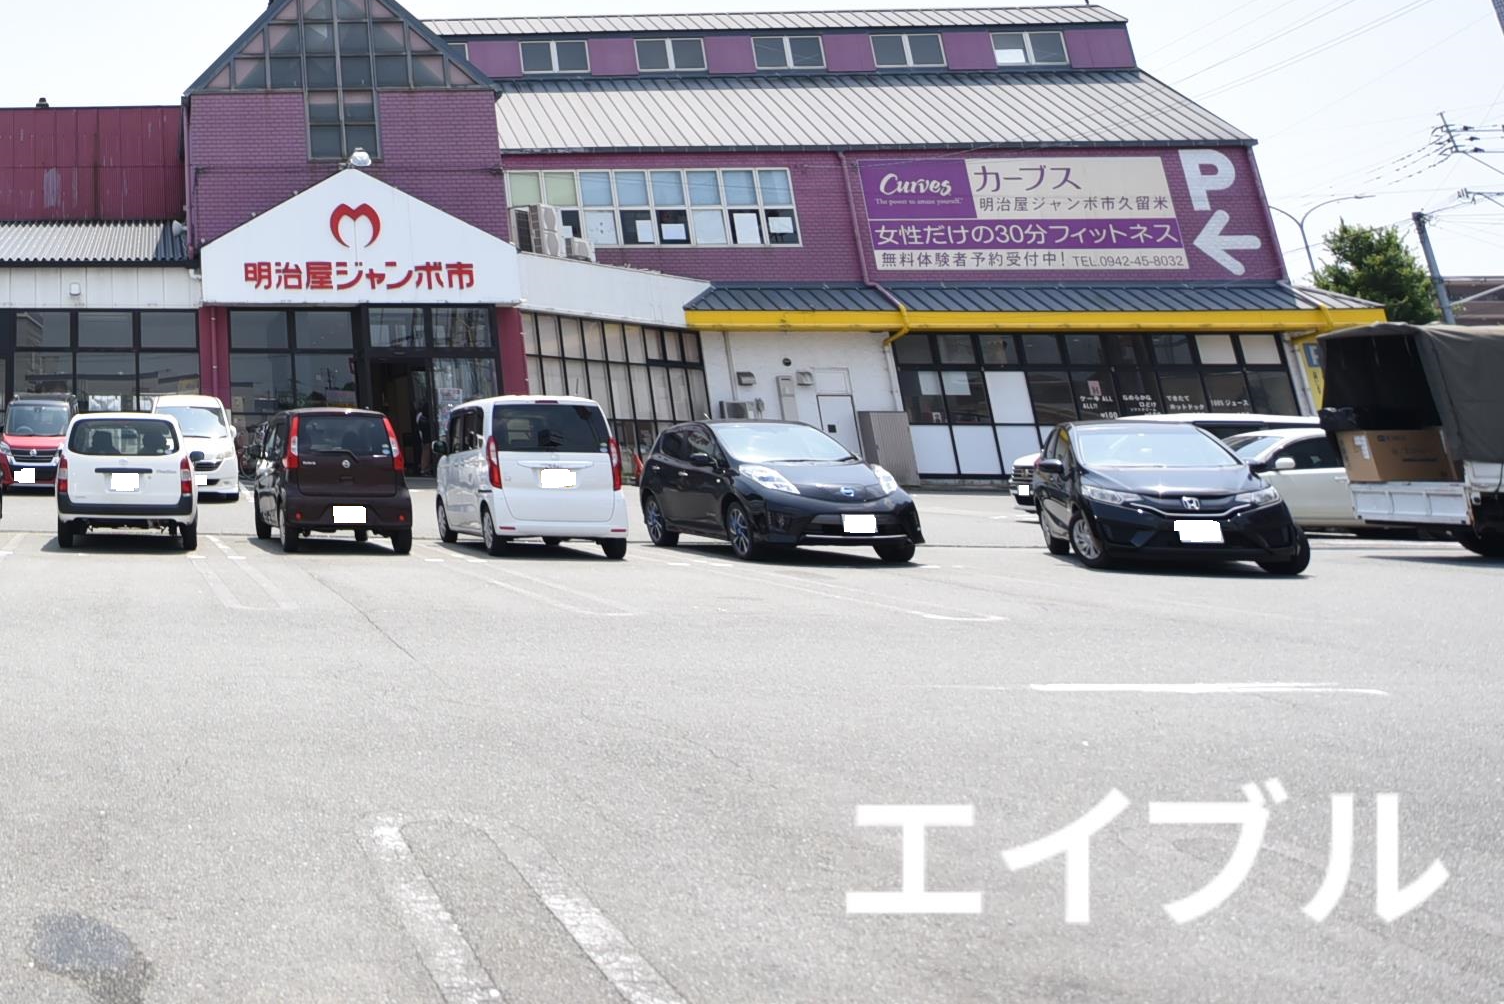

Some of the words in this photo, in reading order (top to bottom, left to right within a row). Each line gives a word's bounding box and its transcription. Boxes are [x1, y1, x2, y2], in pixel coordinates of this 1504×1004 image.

[879, 173, 952, 196] Curves
[974, 165, 1082, 193] カーブス
[1178, 149, 1236, 211] P
[979, 196, 1169, 212] 明治屋ジャンボ市久留米
[874, 224, 1179, 246] 女性だけの30分フィットネス
[1072, 255, 1185, 268] TEL.0942-45-8032
[244, 261, 475, 291] 明治屋ジャンボ市
